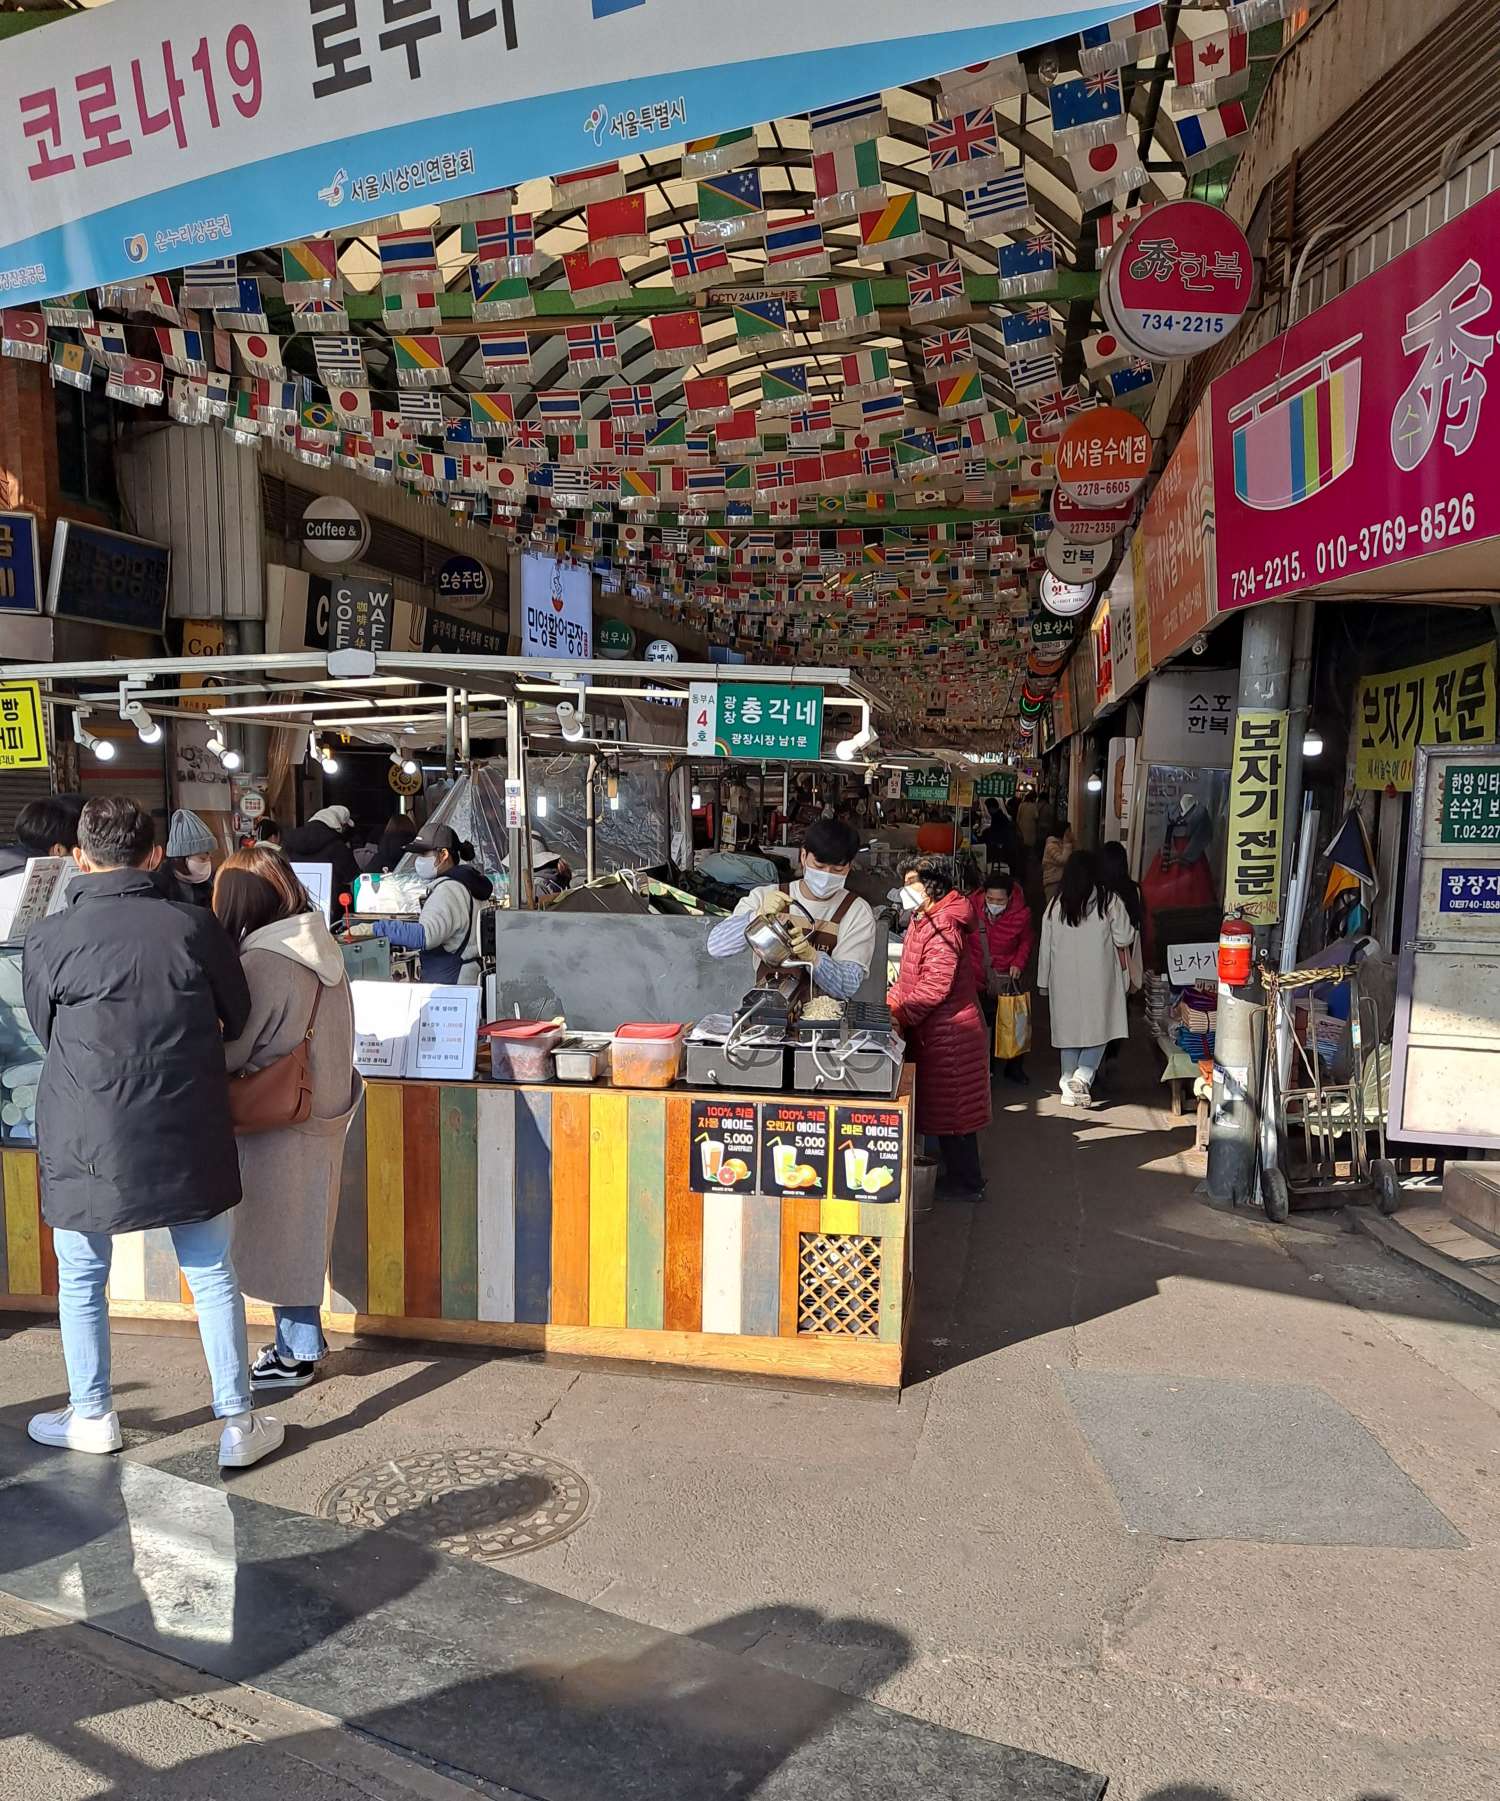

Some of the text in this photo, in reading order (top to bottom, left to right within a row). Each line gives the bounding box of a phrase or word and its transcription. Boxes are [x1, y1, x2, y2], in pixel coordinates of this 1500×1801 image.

[19, 23, 262, 182] 코로나19
[610, 96, 687, 140] 서울특별시
[351, 148, 475, 202] 서울시상인연합회
[155, 214, 233, 252] 온누리상품권
[711, 293, 737, 303] CCTV
[1141, 313, 1224, 333] 734-2215
[1060, 435, 1147, 469] 새서울수예점
[1077, 481, 1130, 496] 2278-6605
[306, 522, 357, 537] Coffee &
[1316, 492, 1475, 575] 010-3769-8526
[1062, 549, 1094, 565] 한복
[440, 571, 484, 589] 오승주단
[528, 606, 584, 657] 민영활어공장
[1033, 619, 1074, 636] 일호상사
[692, 693, 715, 704] 동부A
[1188, 694, 1231, 712] 소호
[1361, 661, 1487, 751] 보자기 전문
[697, 709, 708, 727] 4
[723, 695, 737, 724] 광장
[740, 697, 817, 726] 총각네
[1188, 716, 1229, 735] 한복
[697, 730, 708, 742] 호
[731, 733, 808, 748] 광장시장 남1문
[1236, 720, 1282, 820] 보자기
[1452, 772, 1476, 795] 한양
[1449, 797, 1483, 820] 손수건
[1235, 829, 1277, 896] 전문
[1173, 951, 1217, 972] 보자기
[707, 1107, 734, 1117] 100%
[778, 1110, 805, 1120] 100%
[851, 1113, 878, 1124] 100%
[722, 1118, 754, 1130] 에이드
[766, 1120, 826, 1134] 오렌지 에이드
[841, 1124, 899, 1138] 레몬 에이드
[724, 1132, 754, 1144] 5,000
[795, 1136, 826, 1148] 5,000
[867, 1140, 899, 1152] 4,000
